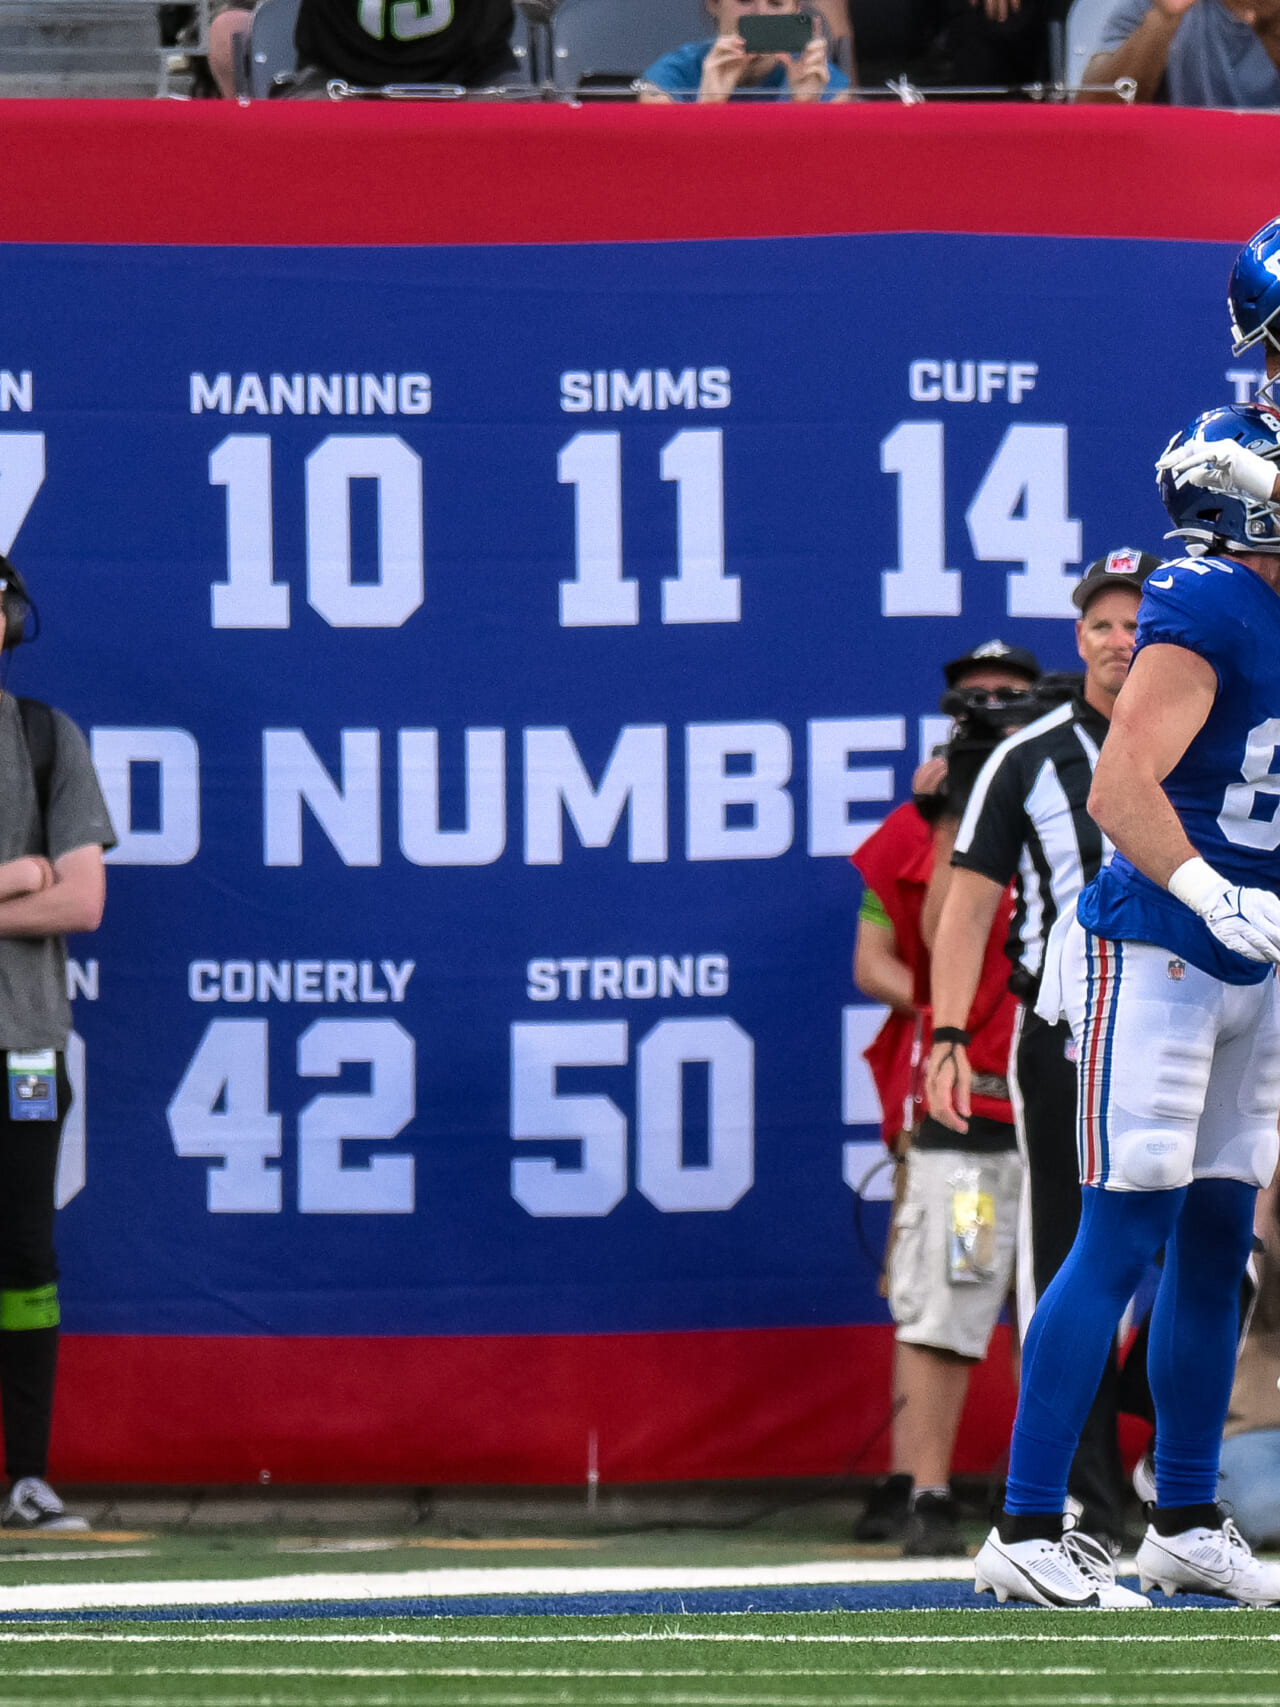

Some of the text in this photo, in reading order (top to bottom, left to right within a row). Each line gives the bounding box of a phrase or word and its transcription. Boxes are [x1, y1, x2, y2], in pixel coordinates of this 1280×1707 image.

[190, 372, 432, 415] MANNING
[560, 367, 731, 412] SIMMS
[909, 360, 1038, 404] CUFF
[208, 433, 424, 629] 10
[557, 427, 741, 628] 11
[880, 420, 1082, 619] 14
[262, 714, 958, 867] NUMBE
[188, 960, 416, 1003] CONERLY
[527, 953, 729, 1001] STRONG
[166, 1017, 416, 1214] 42
[510, 1016, 755, 1218] 50
